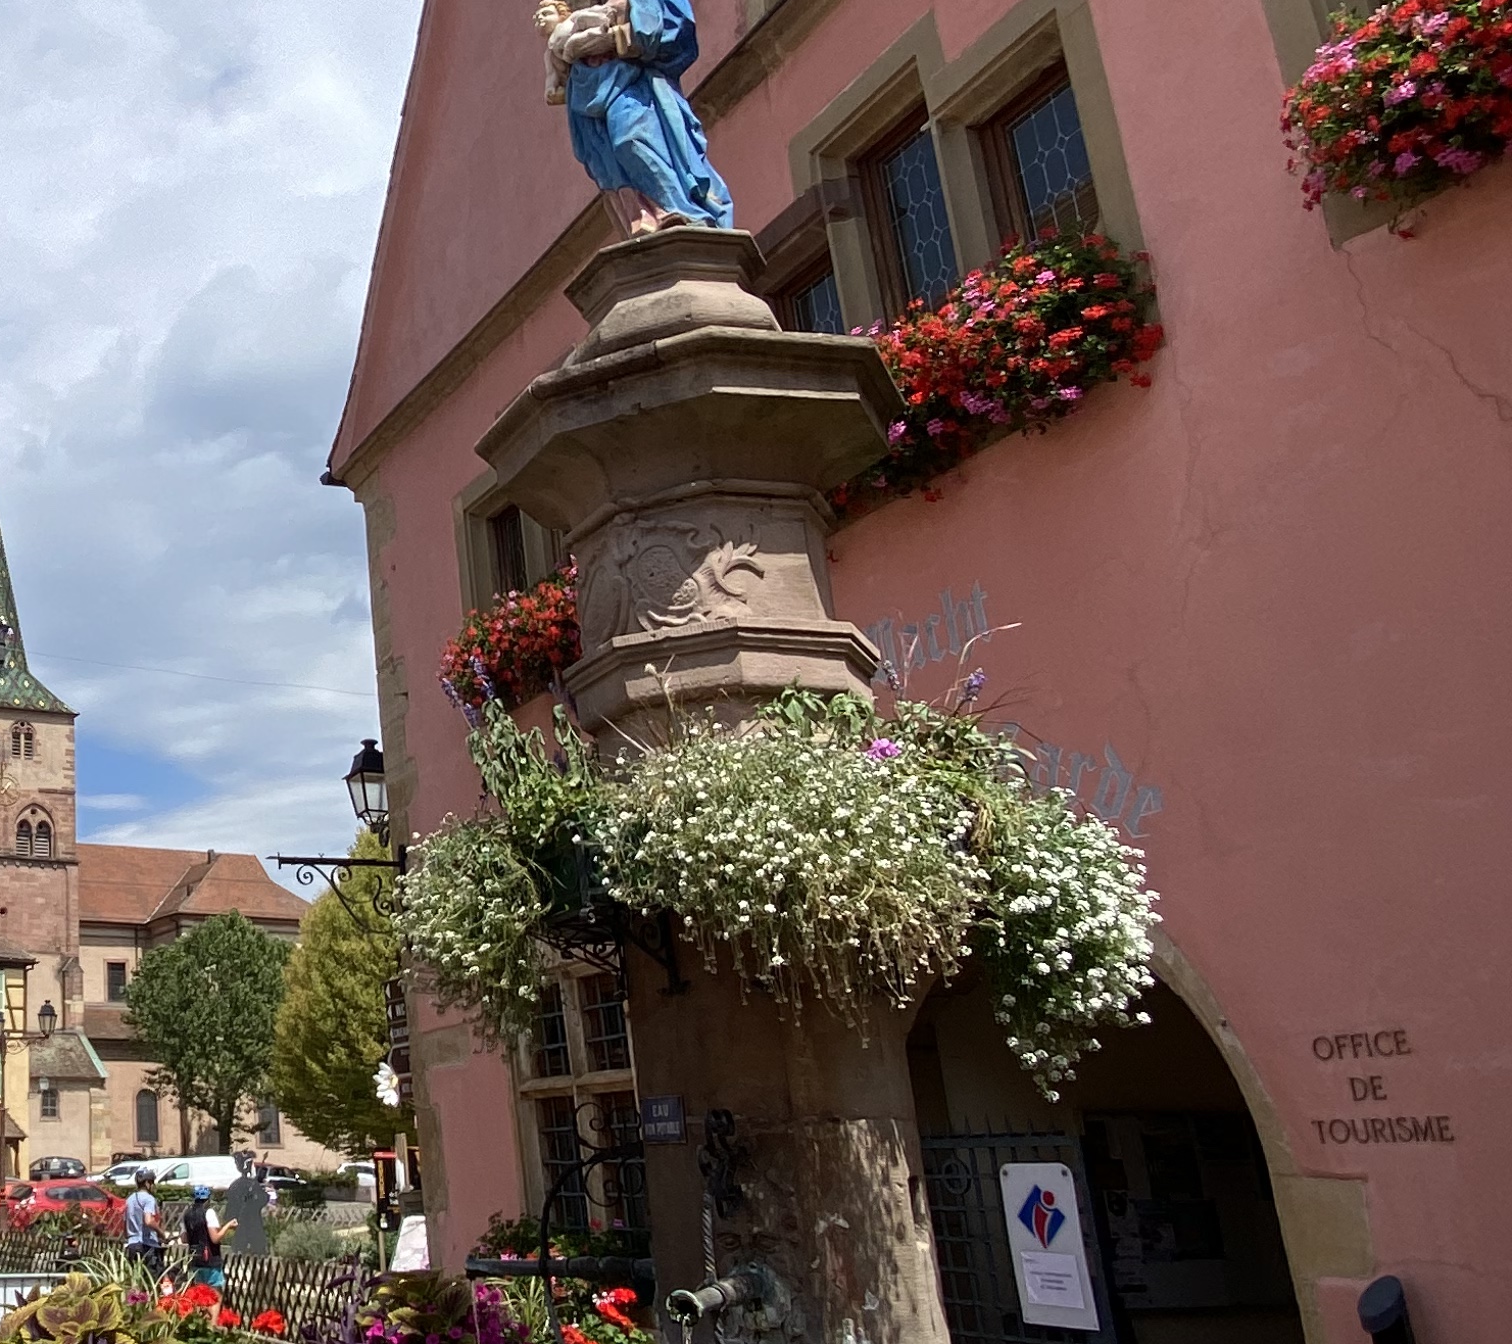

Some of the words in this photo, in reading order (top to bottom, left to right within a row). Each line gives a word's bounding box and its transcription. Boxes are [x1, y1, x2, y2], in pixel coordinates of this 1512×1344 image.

[1312, 1029, 1412, 1061] OFFICE
[1348, 1075, 1387, 1101] DE
[652, 1104, 669, 1117] EAU
[1310, 1115, 1455, 1145] TOURISME
